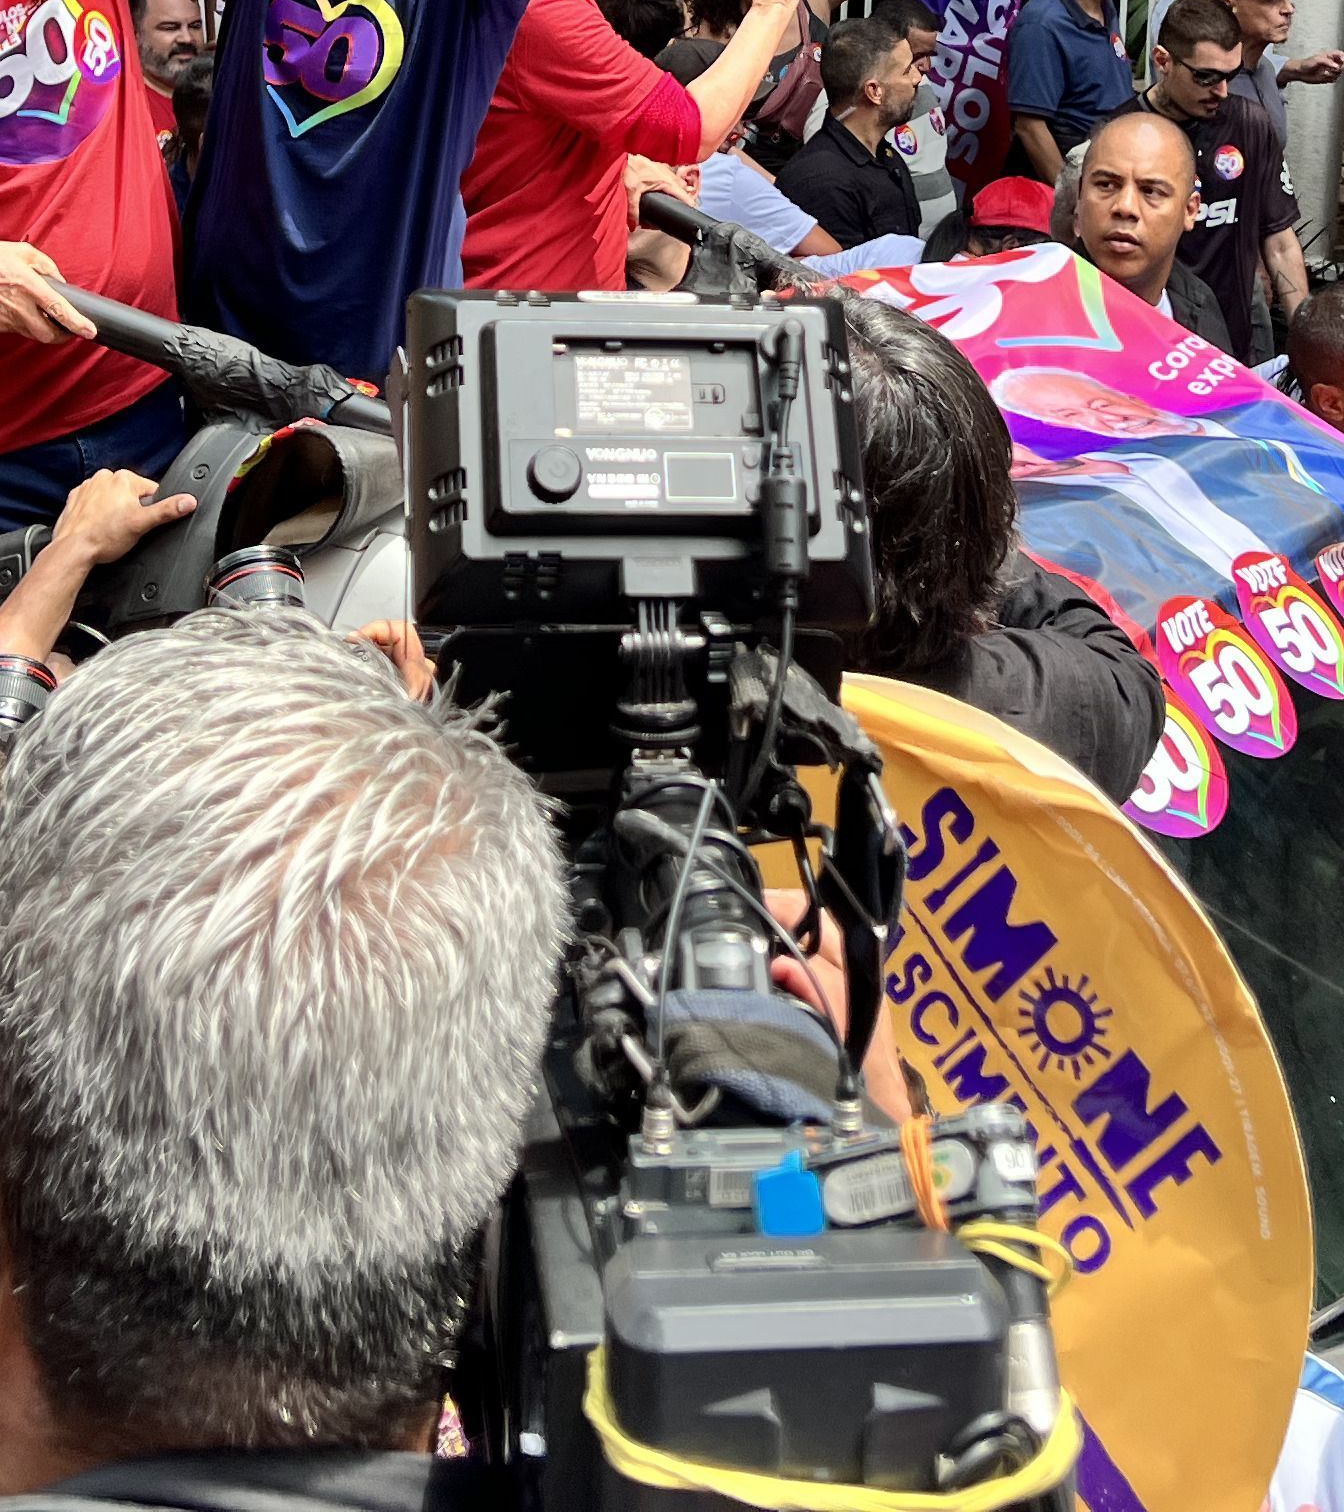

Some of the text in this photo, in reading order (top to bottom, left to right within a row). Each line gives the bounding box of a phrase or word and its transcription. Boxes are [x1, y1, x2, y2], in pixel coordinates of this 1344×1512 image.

[82, 18, 113, 77] 50
[1161, 600, 1217, 653] VOTE
[1258, 601, 1342, 673] 50
[1189, 645, 1275, 735] 50
[898, 785, 1223, 1221] SIMONE
